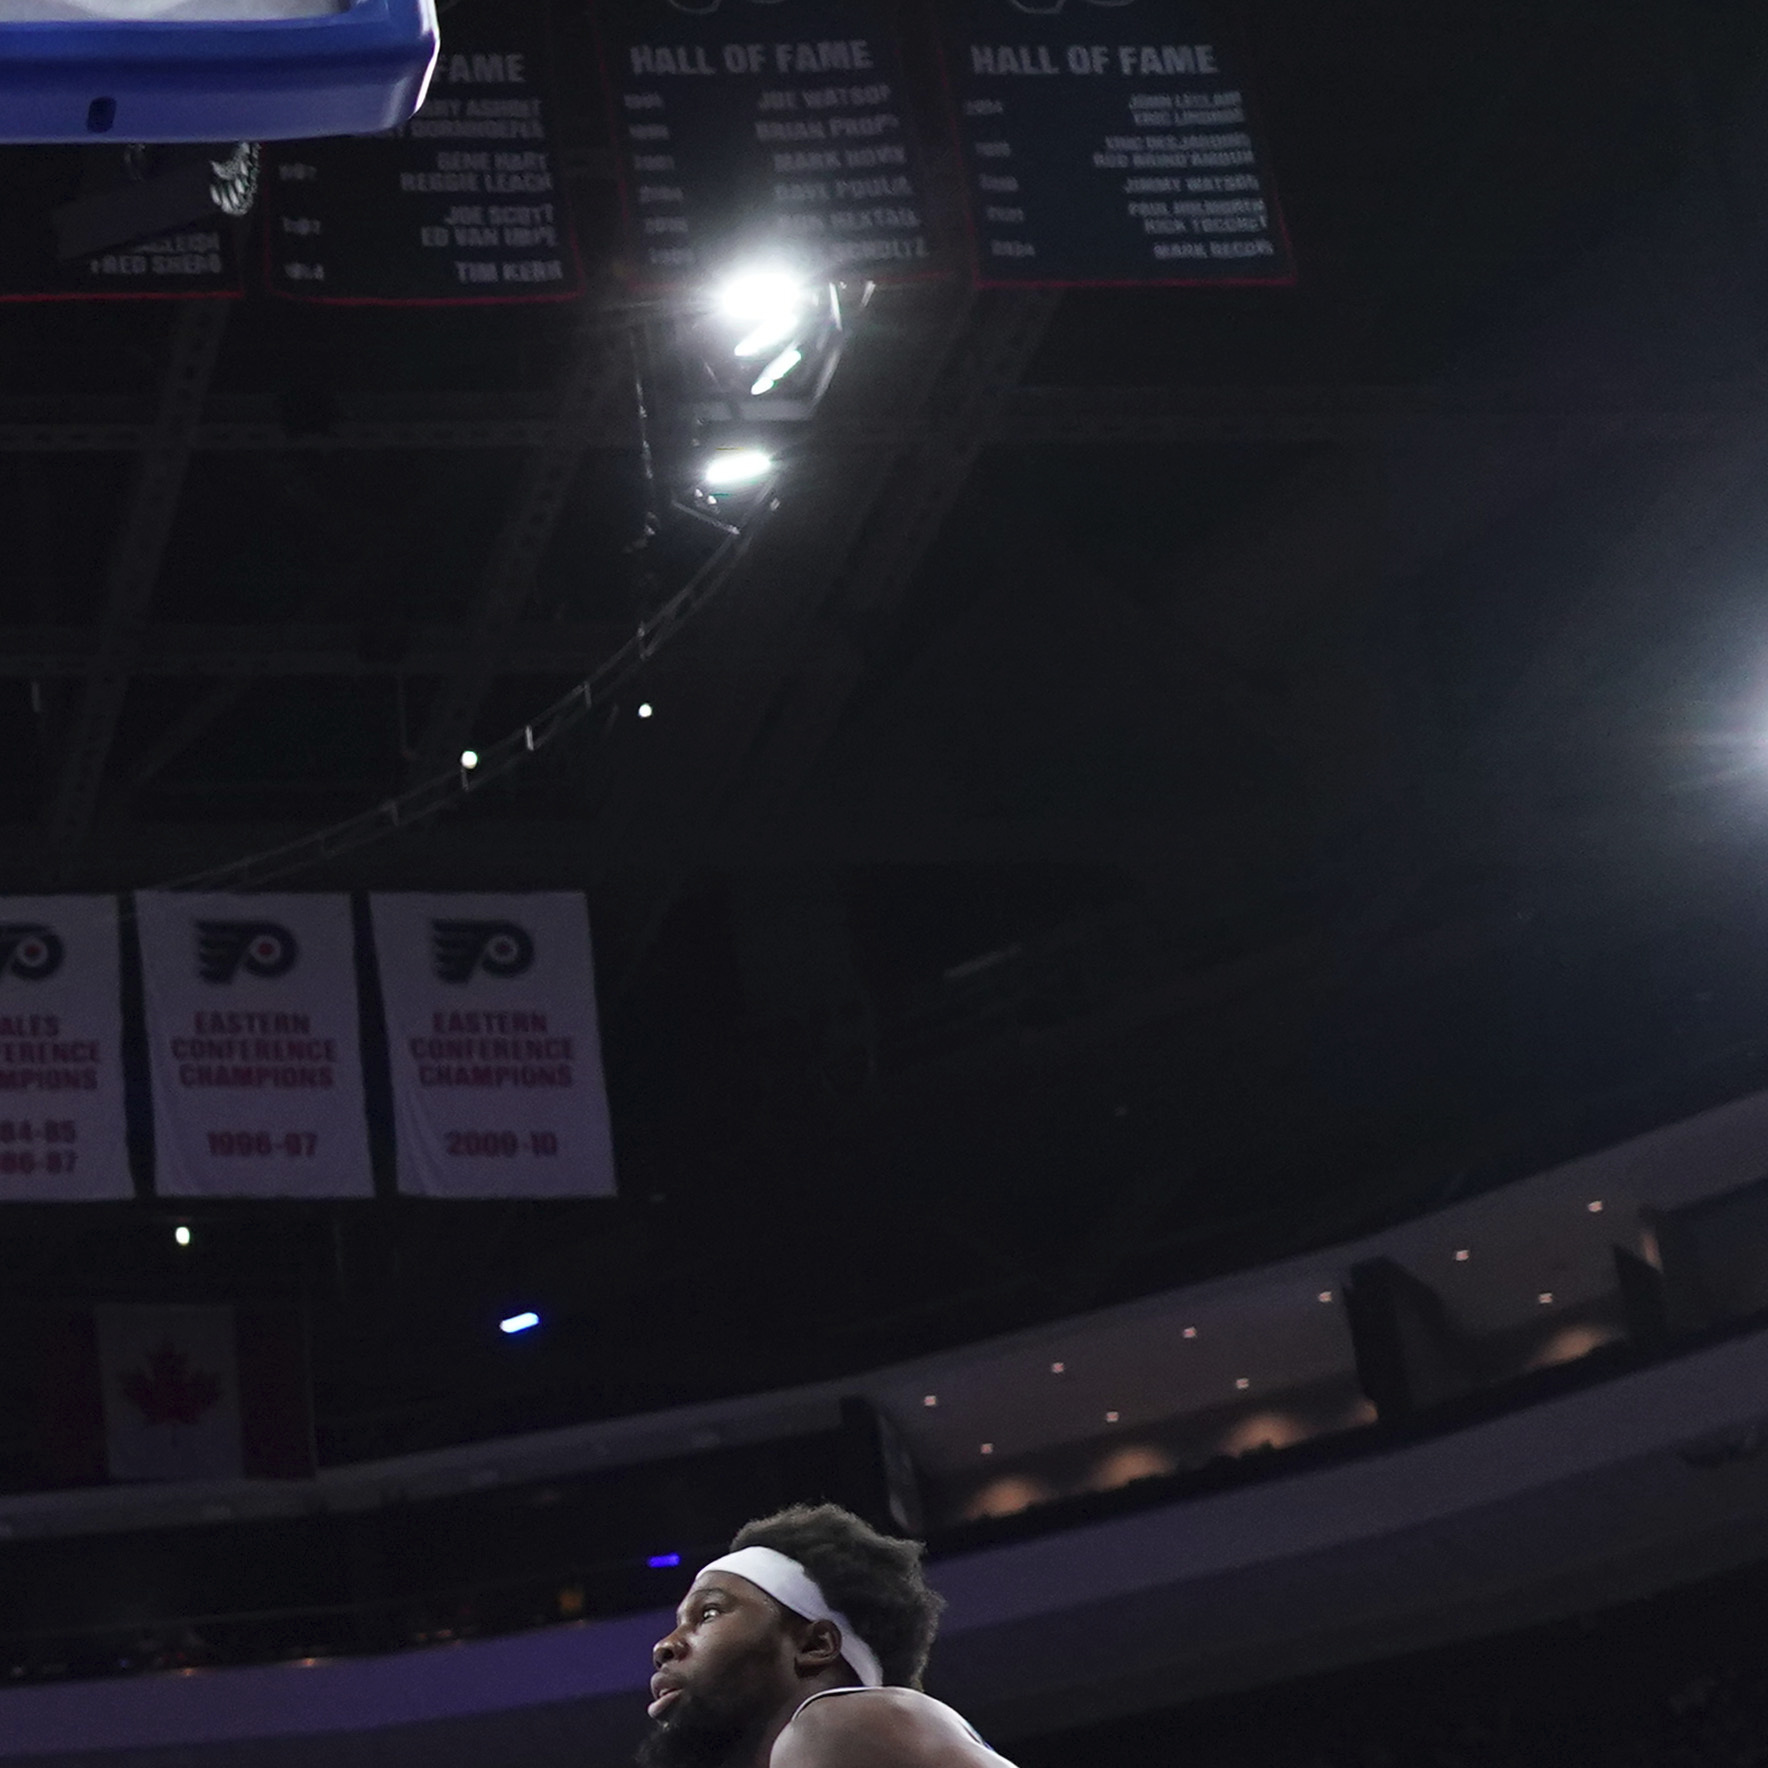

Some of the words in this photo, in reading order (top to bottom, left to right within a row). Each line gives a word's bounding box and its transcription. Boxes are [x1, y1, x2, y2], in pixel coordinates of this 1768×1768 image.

[630, 44, 715, 75] HALL
[726, 43, 768, 73] OF
[776, 40, 874, 71] FAME
[971, 45, 1059, 75] HALL
[1068, 45, 1112, 74] OF
[1120, 45, 1218, 74] FAME
[193, 1012, 310, 1036] EASTERN
[432, 1012, 548, 1035] EASTERN
[172, 1037, 337, 1062] CONFERENCE
[410, 1037, 574, 1062] CONFERENCE
[179, 1065, 334, 1089] CHAMPIONS
[419, 1065, 573, 1089] CHAMPIONS
